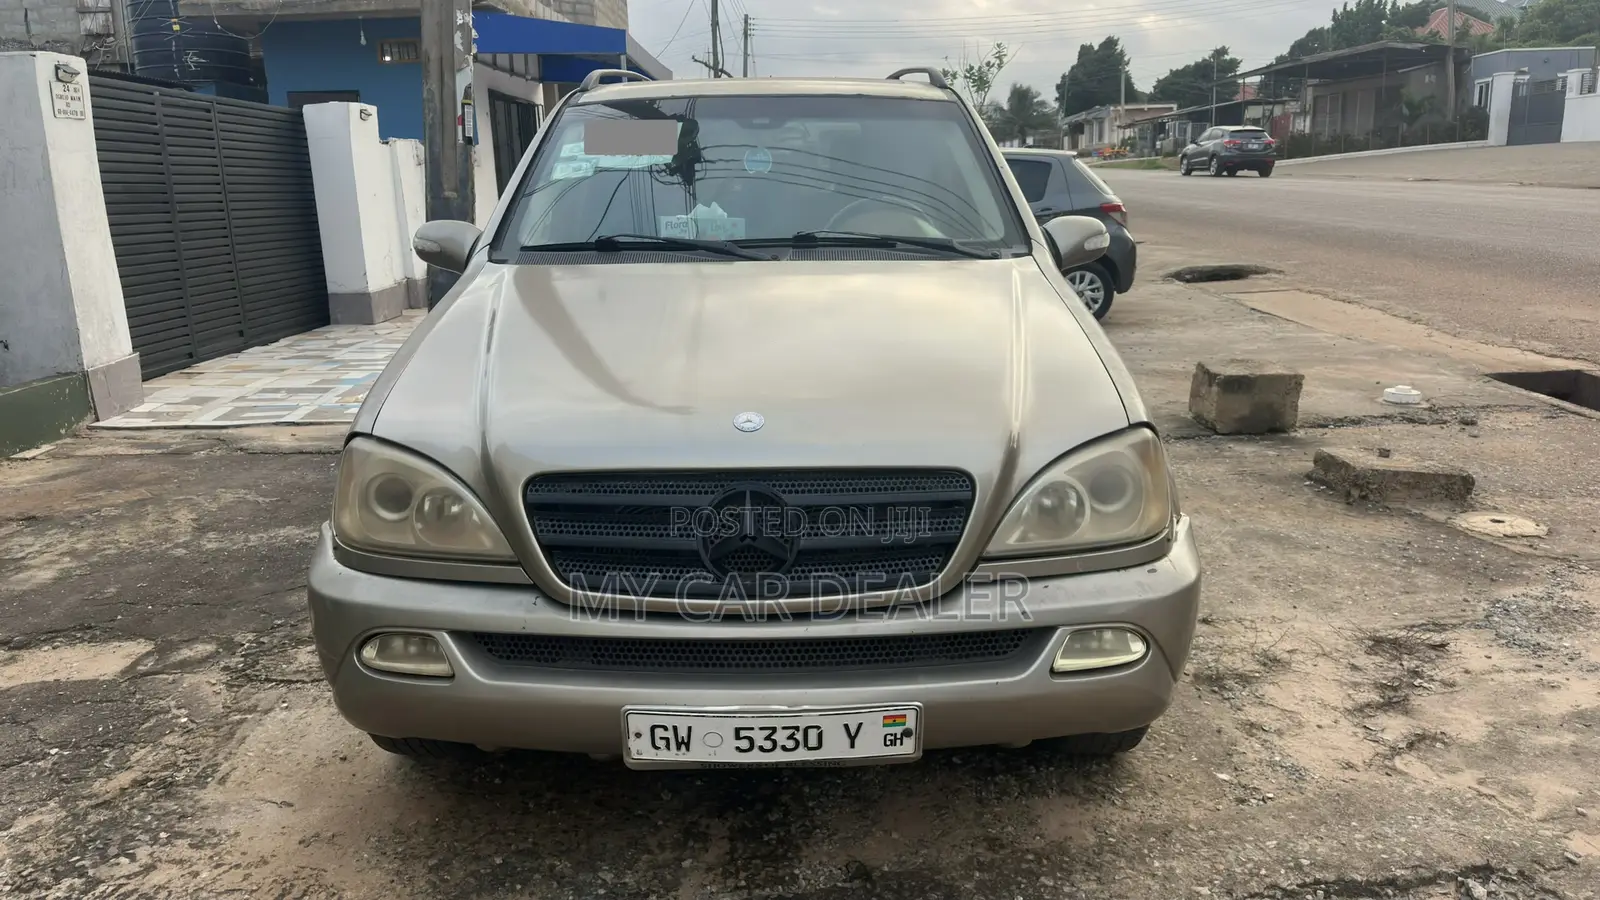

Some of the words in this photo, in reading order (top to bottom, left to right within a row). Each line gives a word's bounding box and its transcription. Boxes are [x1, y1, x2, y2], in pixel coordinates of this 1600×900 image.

[63, 84, 70, 92] 24
[665, 221, 688, 230] Flora
[650, 724, 692, 751] GW
[734, 725, 824, 753] 5330
[843, 722, 863, 749] Y
[883, 732, 904, 747] GH
